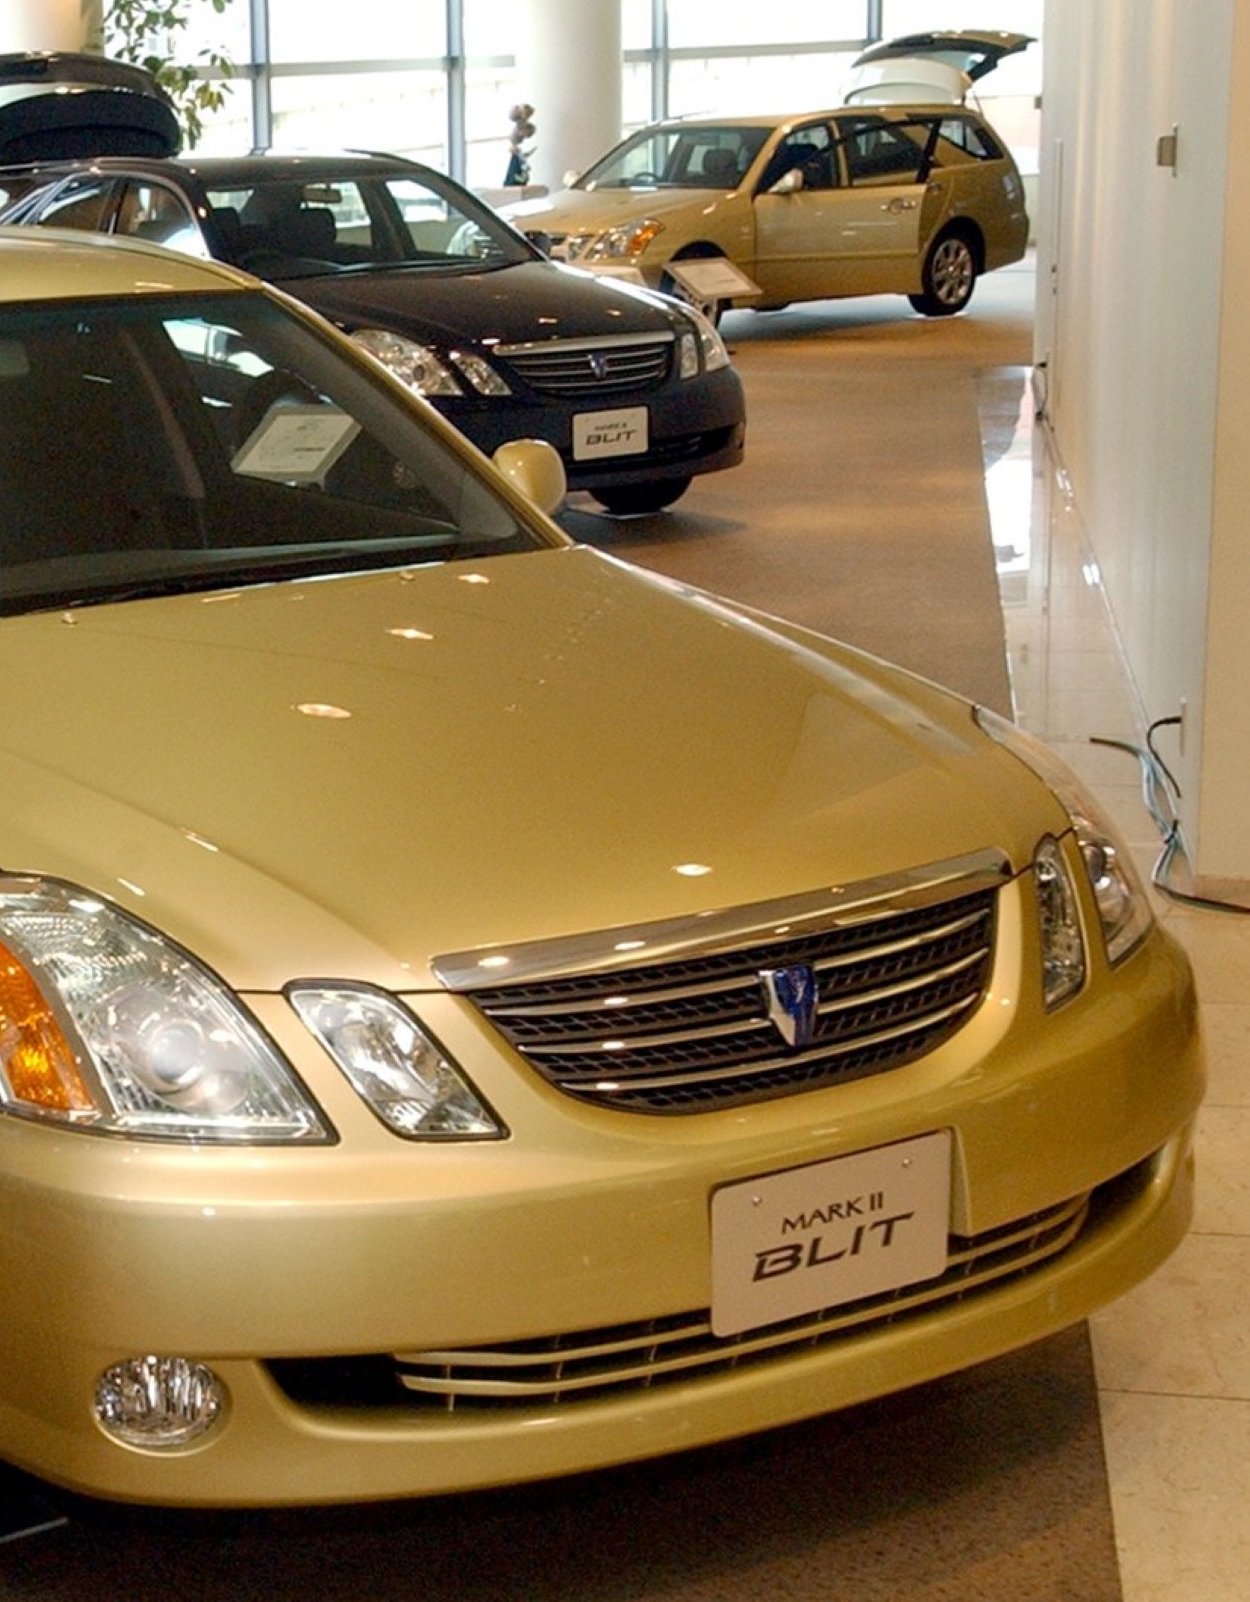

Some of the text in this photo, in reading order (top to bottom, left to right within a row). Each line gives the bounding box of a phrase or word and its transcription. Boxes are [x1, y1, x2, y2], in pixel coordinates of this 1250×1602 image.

[781, 1191, 884, 1235] MARK II
[752, 1211, 916, 1283] BLIT
